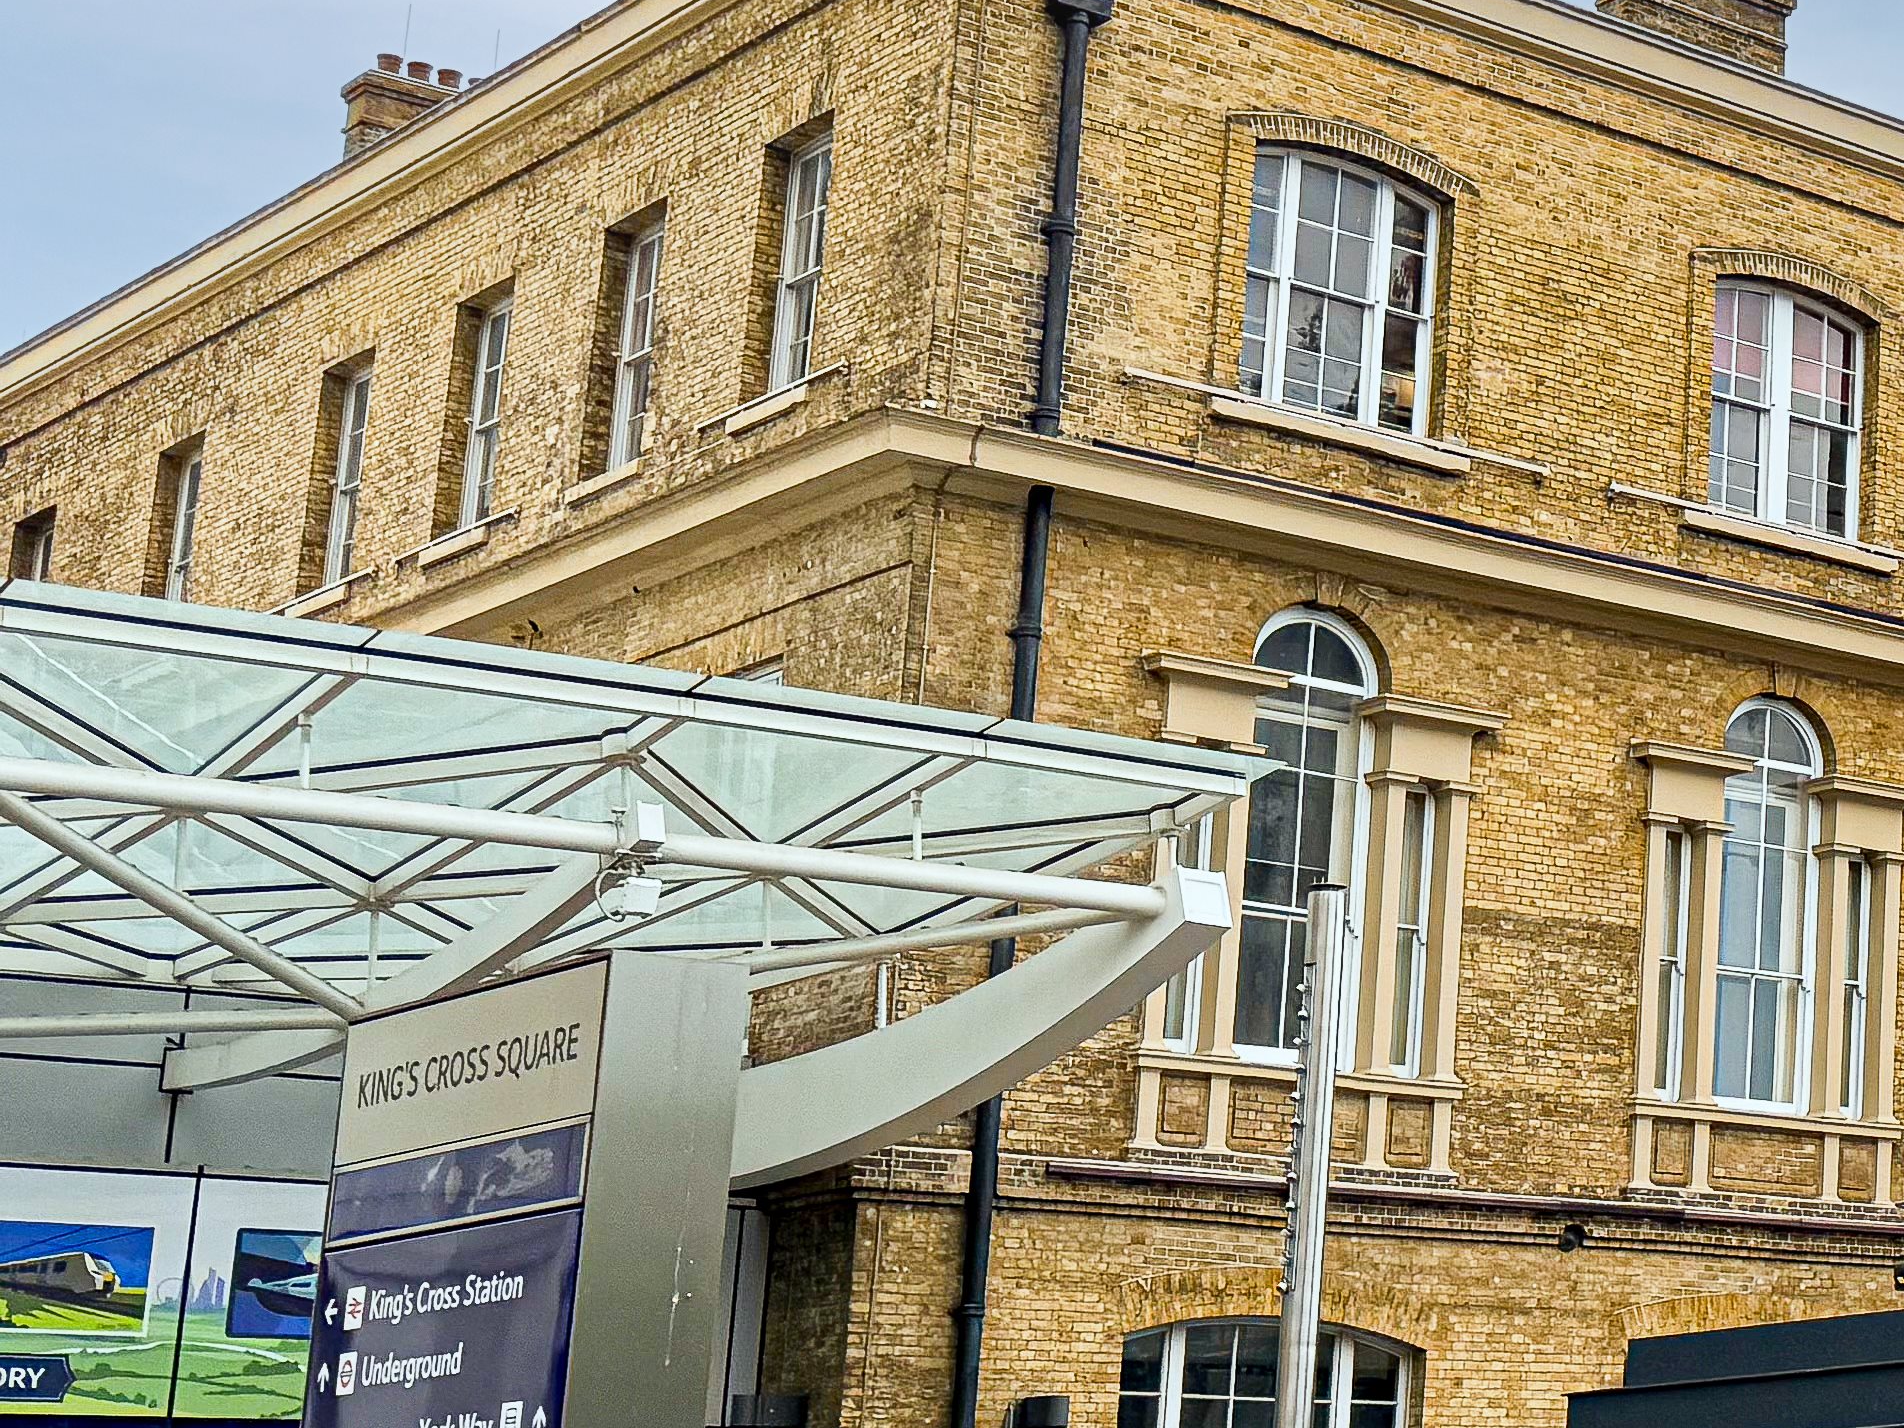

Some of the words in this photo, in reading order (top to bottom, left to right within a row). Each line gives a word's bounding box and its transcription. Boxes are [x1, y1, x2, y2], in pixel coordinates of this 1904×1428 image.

[358, 1061, 419, 1109] KING'S
[424, 1044, 491, 1093] CROSS
[494, 1022, 580, 1079] SQUARE
[369, 1284, 414, 1324] King's
[416, 1281, 461, 1313] Cross
[463, 1270, 524, 1306] Station
[361, 1341, 464, 1389] Underground
